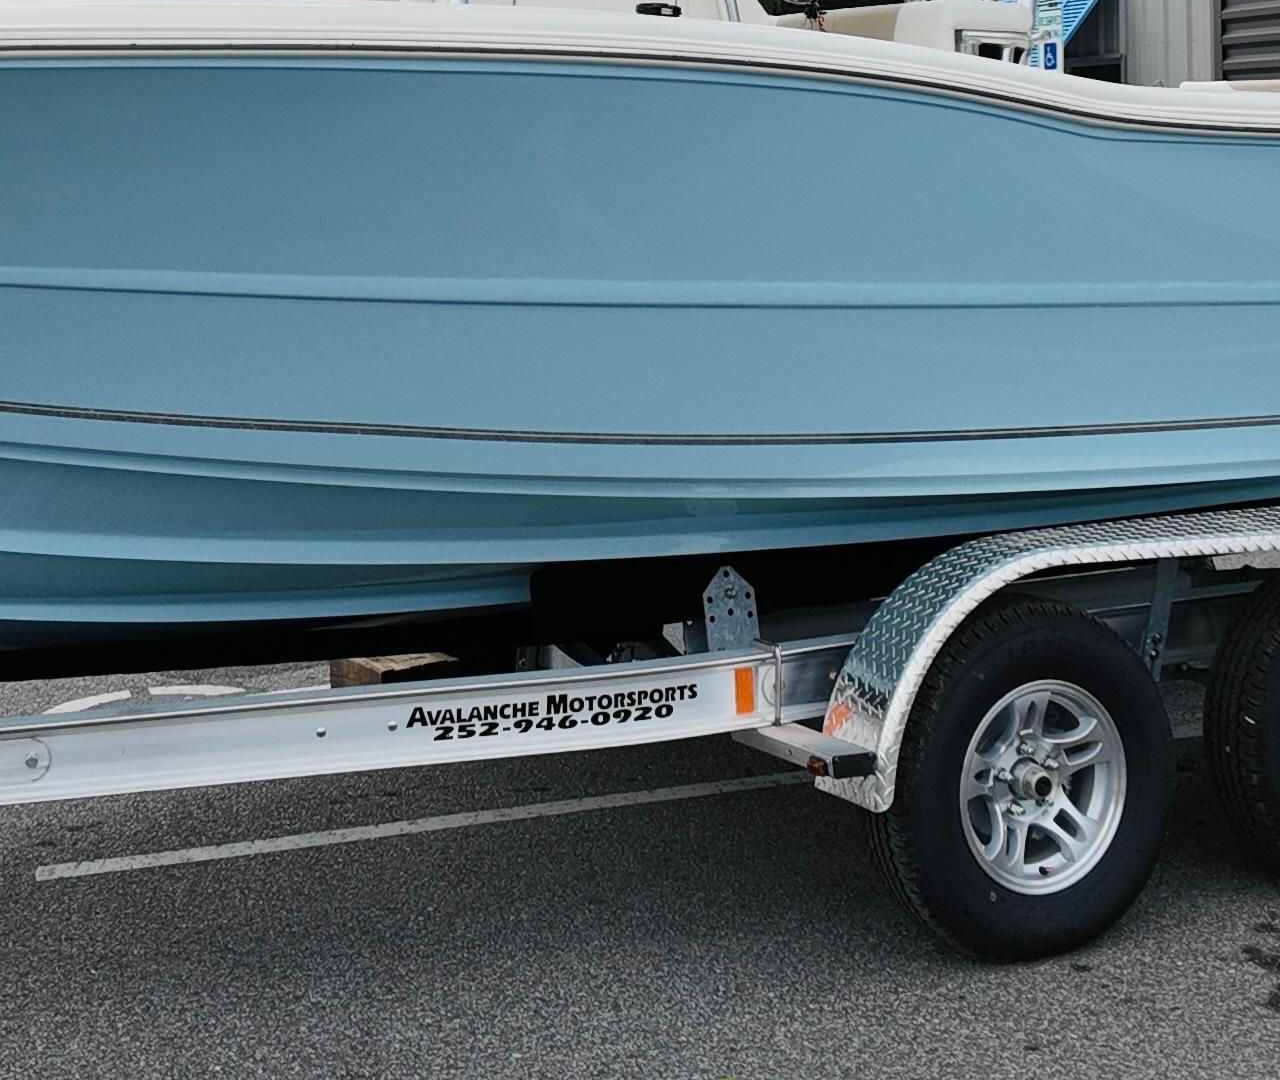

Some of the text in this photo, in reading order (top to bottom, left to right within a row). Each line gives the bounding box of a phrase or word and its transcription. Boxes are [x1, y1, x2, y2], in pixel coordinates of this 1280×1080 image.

[406, 683, 699, 728] AVALANCHE MOTORSPORTS
[432, 703, 675, 741] 252-946-0920
